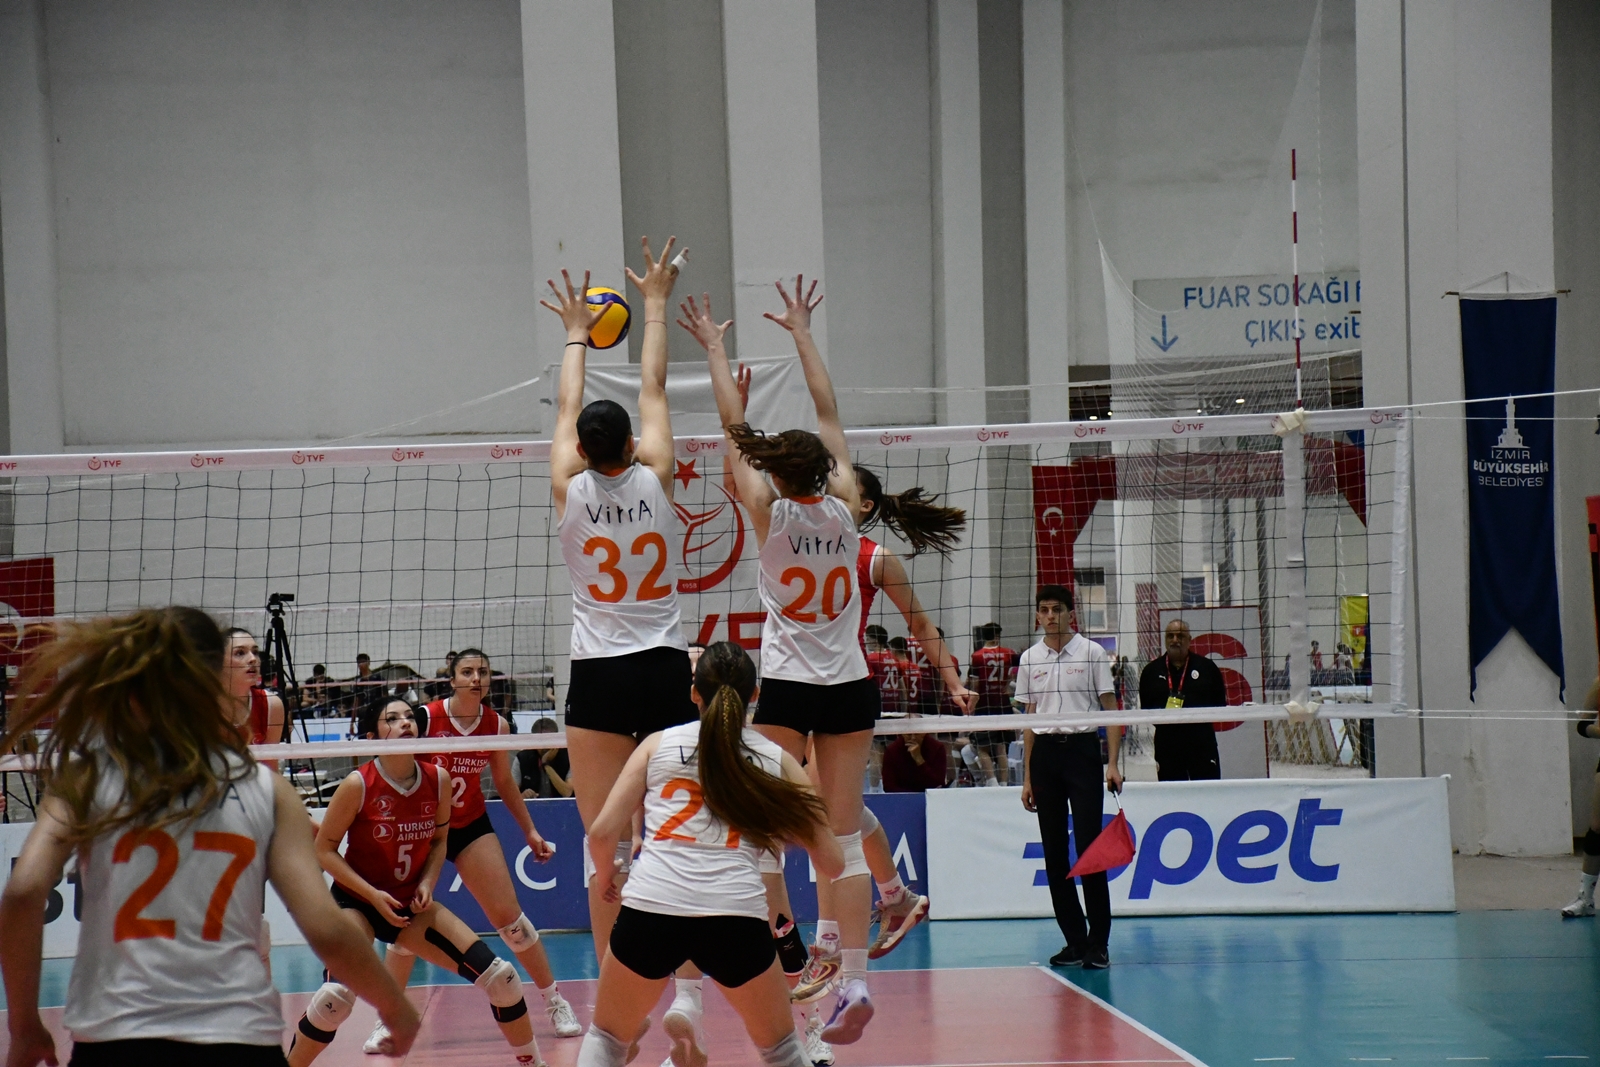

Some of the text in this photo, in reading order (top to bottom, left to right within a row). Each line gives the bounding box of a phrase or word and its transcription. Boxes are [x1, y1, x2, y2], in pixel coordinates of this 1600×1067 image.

[1183, 284, 1250, 309] FUAR
[1257, 277, 1349, 307] SOKAĞI
[1314, 316, 1361, 340] exit
[1089, 427, 1107, 435] TVF
[1186, 423, 1205, 432] TVF
[894, 434, 913, 443] TVF
[991, 431, 1010, 439] TVF
[699, 441, 718, 450] TVF
[306, 454, 325, 462] TVF
[406, 451, 425, 459] TVF
[505, 448, 524, 456] TVF
[1491, 448, 1530, 459] İZMİR
[103, 460, 122, 468] TVF
[206, 457, 224, 465] TVF
[1473, 459, 1549, 475] BÜYÜKŞEHİR
[1478, 476, 1544, 487] BELEDİYES
[585, 499, 653, 524] VitrA
[582, 532, 672, 603] 32
[779, 566, 851, 623] 20
[987, 660, 1005, 682] 21
[882, 666, 899, 689] 20
[909, 676, 918, 698] 3
[453, 757, 488, 767] TURKISH
[653, 777, 741, 850] 2
[397, 819, 435, 833] TURKISH
[394, 844, 414, 881] 5
[112, 826, 256, 943] 27
